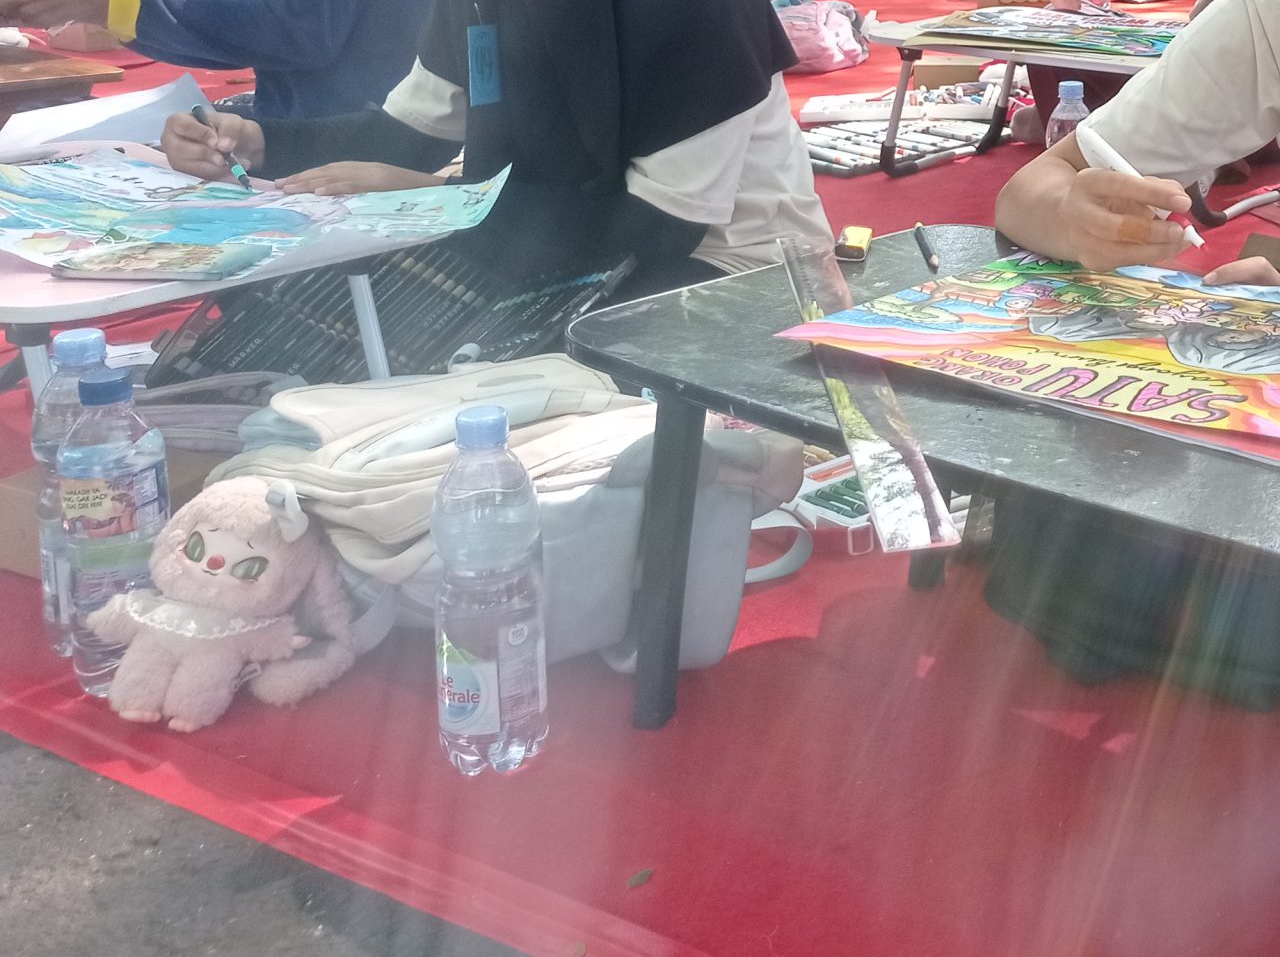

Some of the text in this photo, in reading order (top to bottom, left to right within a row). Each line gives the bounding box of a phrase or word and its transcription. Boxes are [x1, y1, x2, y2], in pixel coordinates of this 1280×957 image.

[940, 346, 1052, 376] POHON
[919, 355, 1249, 424] SATU ORANG
[440, 687, 480, 704] nerale
